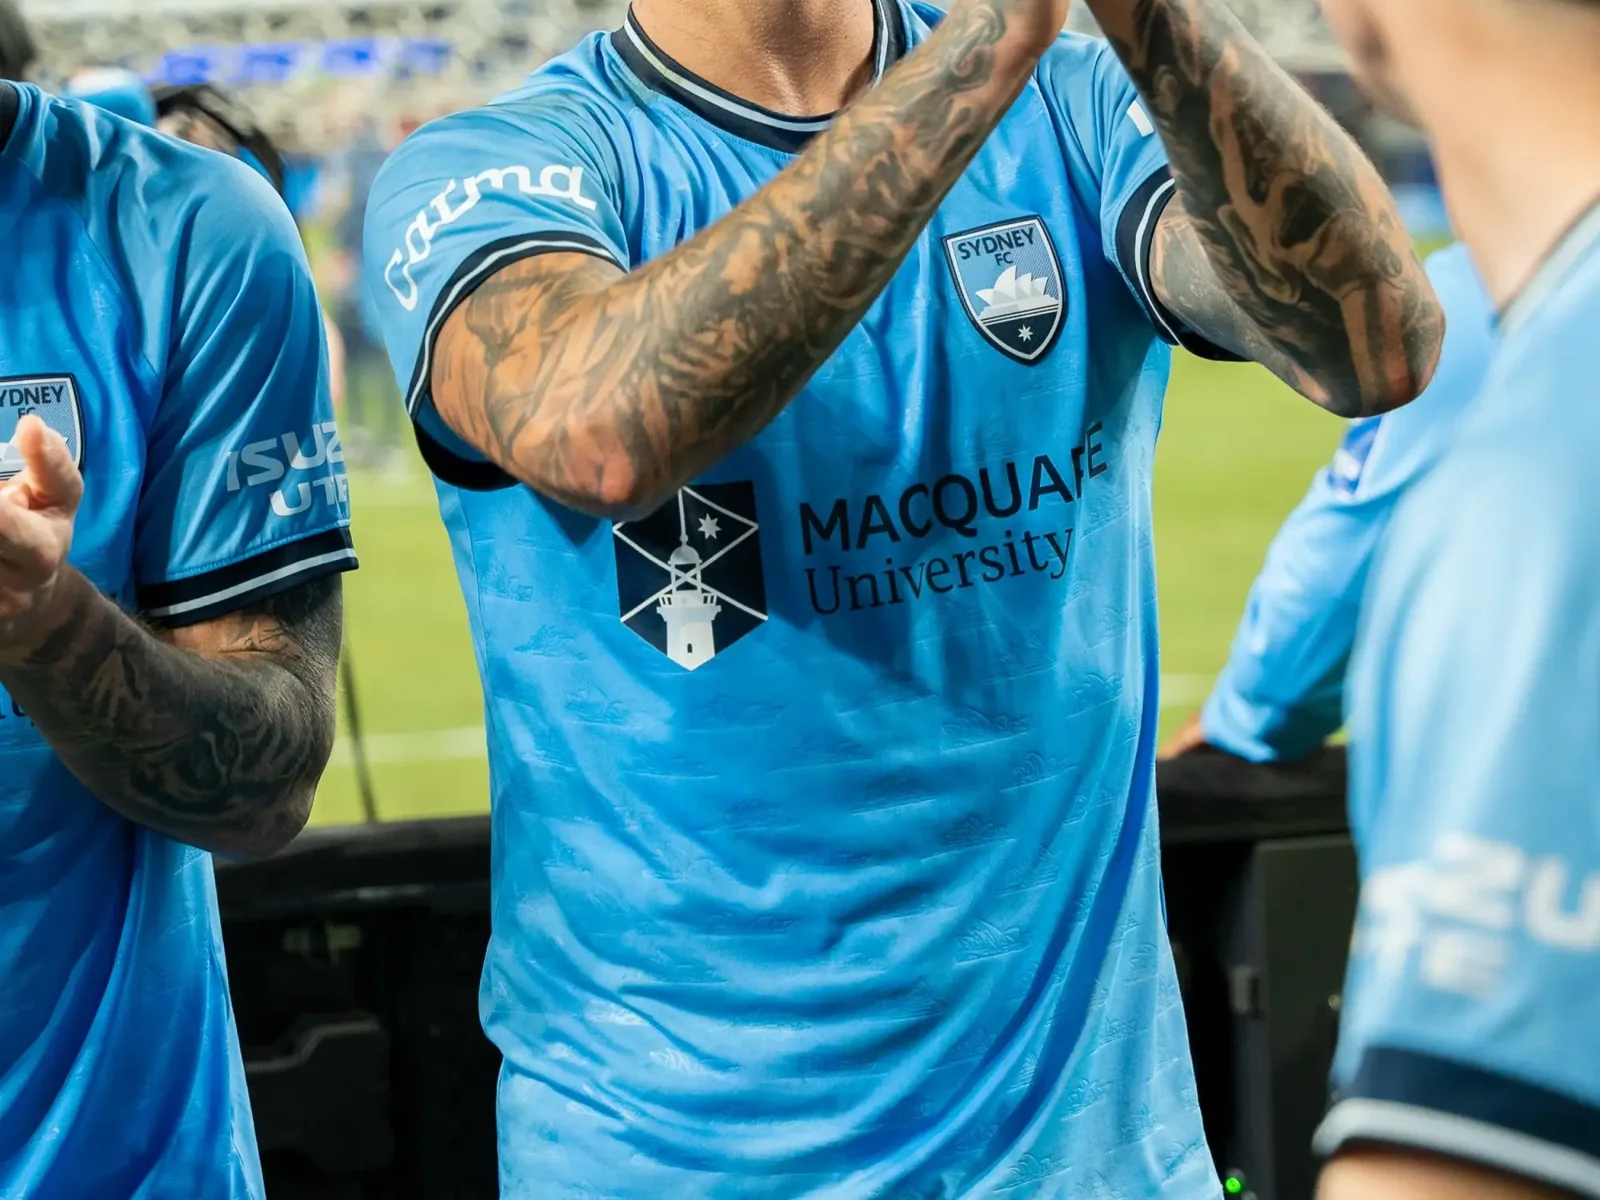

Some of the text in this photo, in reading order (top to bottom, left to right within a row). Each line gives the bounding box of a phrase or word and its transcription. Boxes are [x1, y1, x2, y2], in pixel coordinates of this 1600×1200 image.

[957, 227, 1034, 260] SYDNEY
[995, 251, 1014, 266] FC
[0, 386, 64, 408] YDNEY
[226, 421, 345, 492] ISUZ
[805, 528, 1074, 616] University
